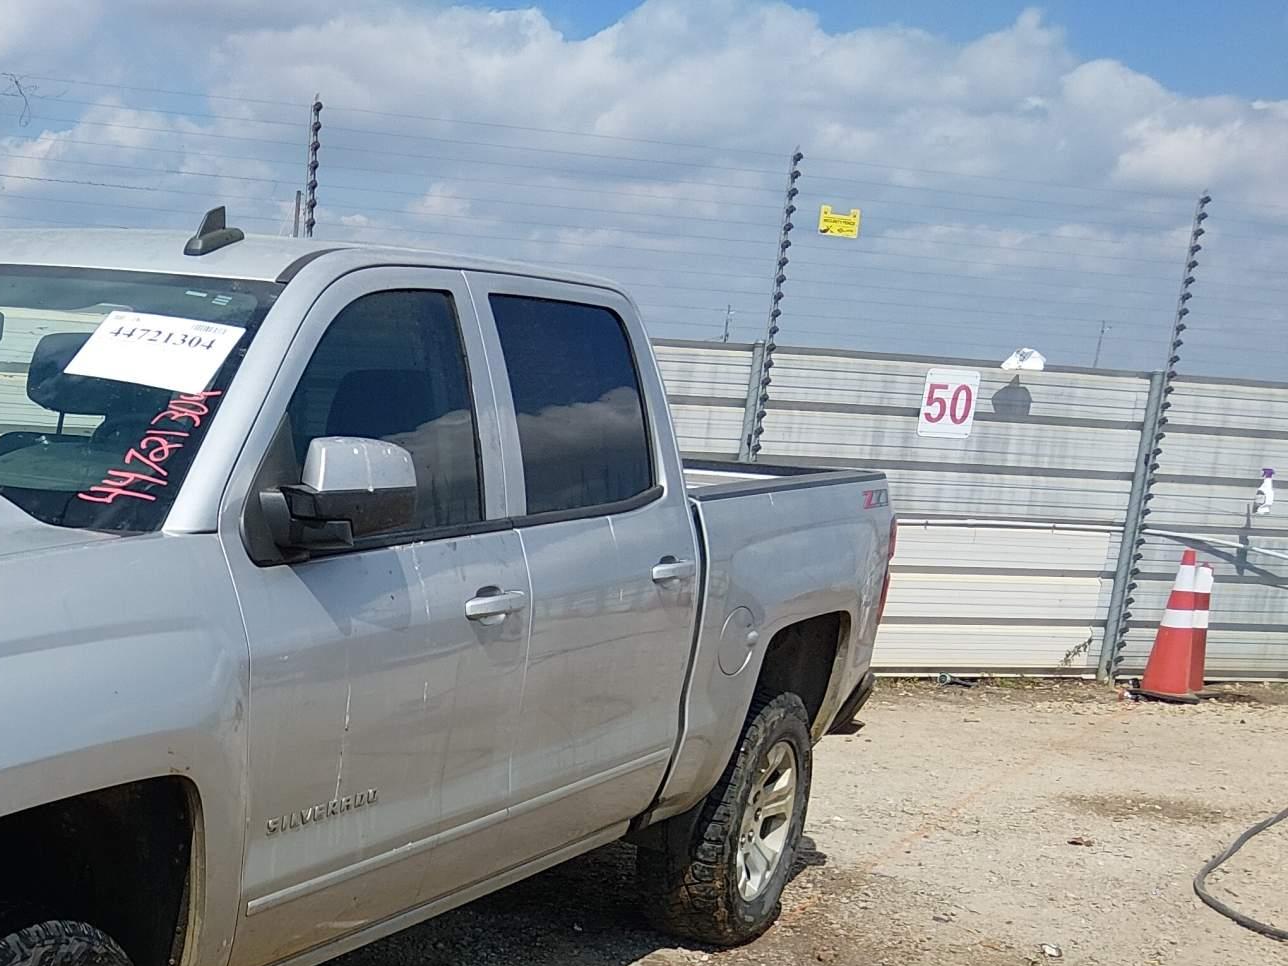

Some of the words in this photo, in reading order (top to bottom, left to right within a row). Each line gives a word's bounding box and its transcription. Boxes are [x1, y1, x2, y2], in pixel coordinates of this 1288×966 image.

[109, 326, 217, 350] 44721304
[923, 383, 972, 425] 50
[77, 389, 223, 505] 44721304
[266, 788, 378, 836] SILVERADO
